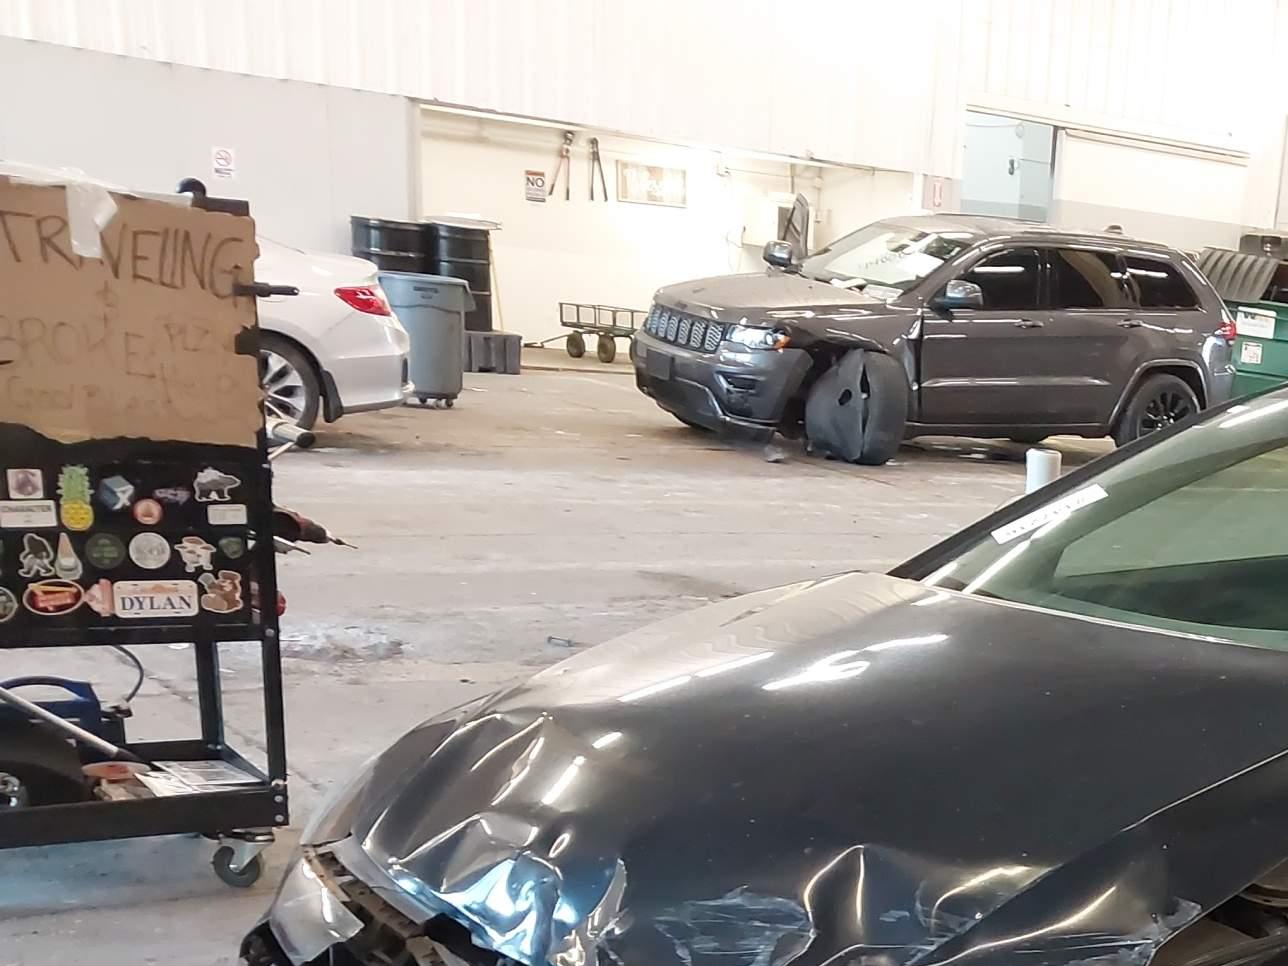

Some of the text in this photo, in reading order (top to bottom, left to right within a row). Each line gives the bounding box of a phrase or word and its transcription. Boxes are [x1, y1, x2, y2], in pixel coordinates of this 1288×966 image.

[526, 176, 546, 188] NO
[0, 210, 246, 305] TRVELING
[120, 596, 192, 611] DYLAN
